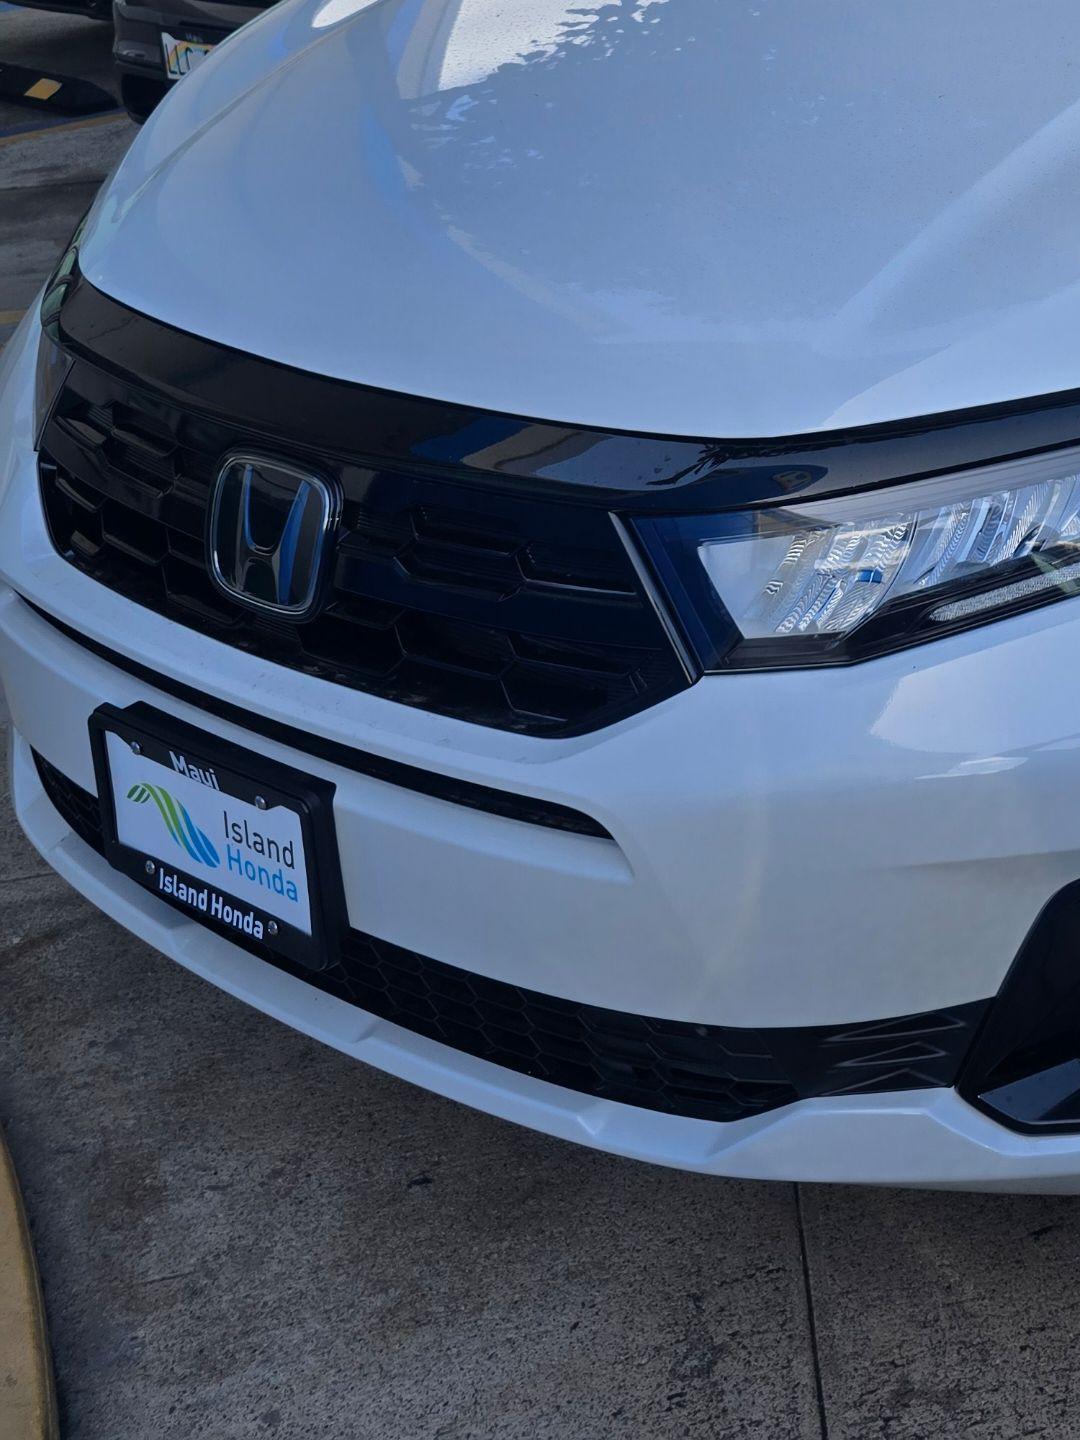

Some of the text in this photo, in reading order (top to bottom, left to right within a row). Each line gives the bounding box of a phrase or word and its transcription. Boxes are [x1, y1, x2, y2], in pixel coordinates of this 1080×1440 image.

[169, 750, 219, 791] Maui
[223, 810, 295, 869] Island
[226, 844, 298, 902] Honda
[159, 867, 263, 940] Island Honda
